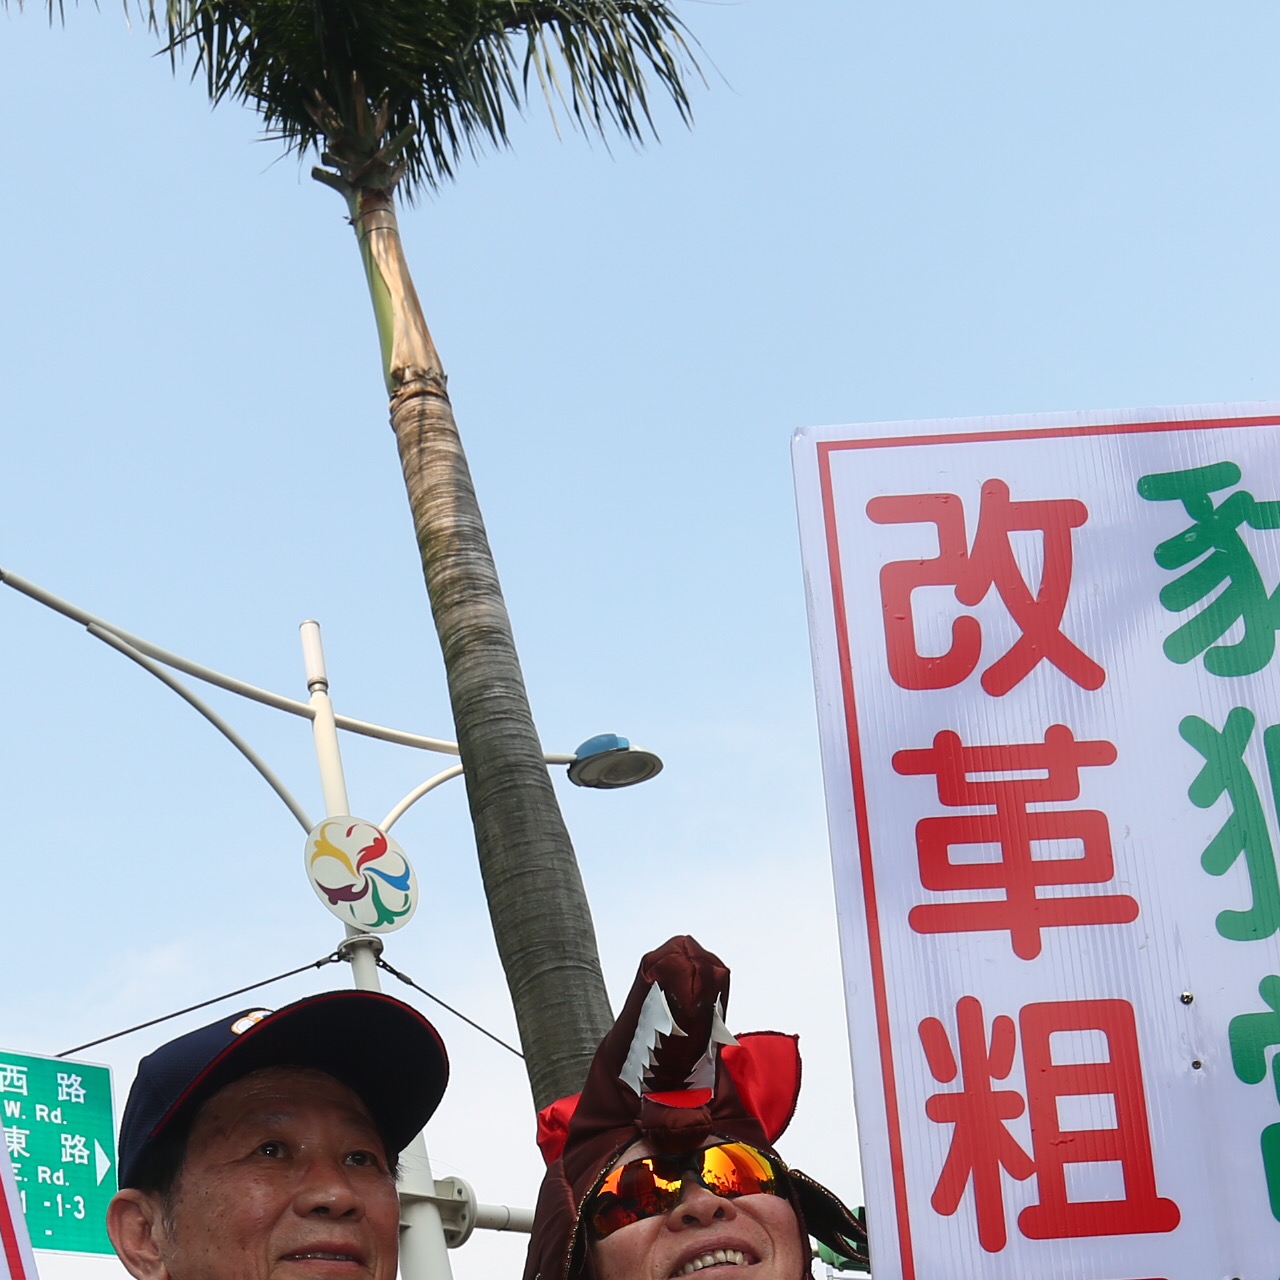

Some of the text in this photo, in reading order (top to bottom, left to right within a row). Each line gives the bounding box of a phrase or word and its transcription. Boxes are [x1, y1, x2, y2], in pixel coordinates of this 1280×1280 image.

[3, 1099, 68, 1125] W. Rd.
[37, 1165, 70, 1187] Rd.
